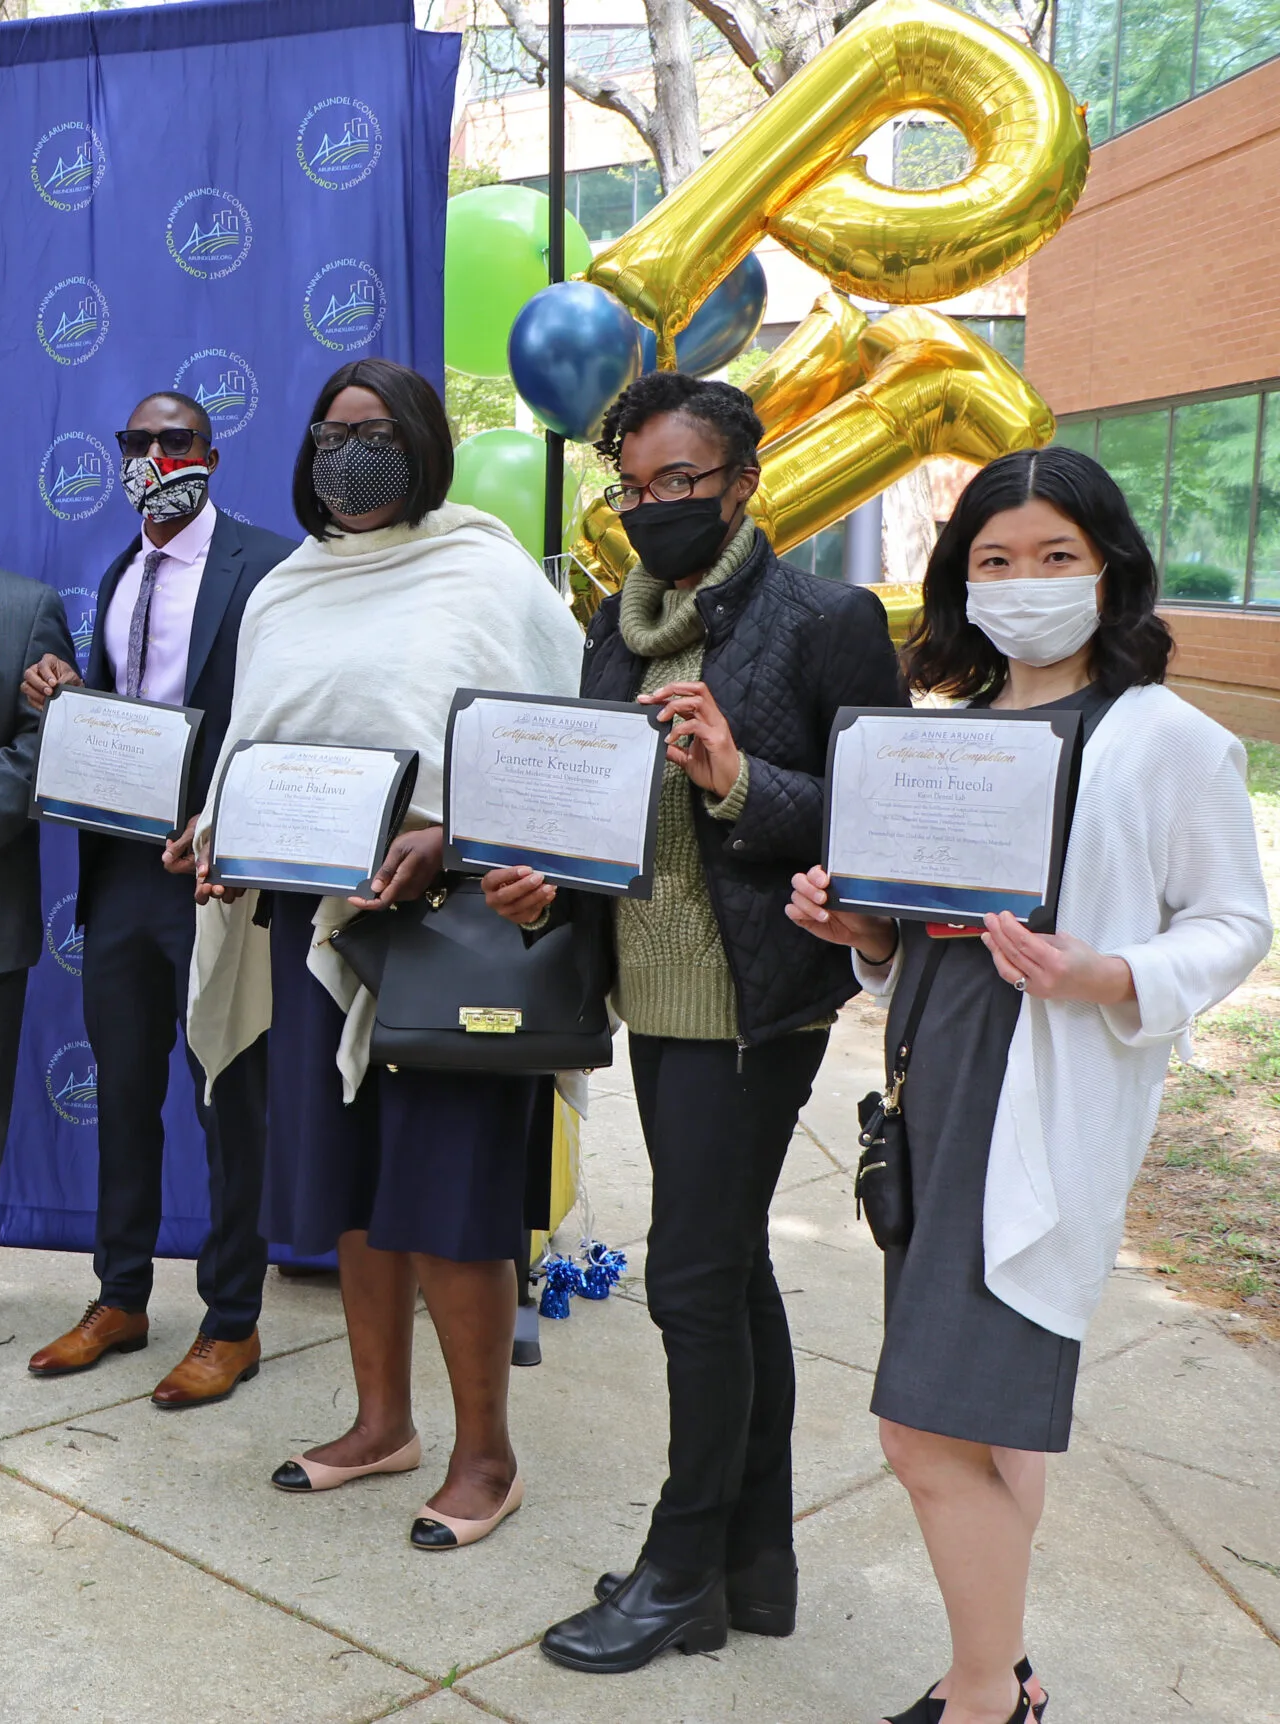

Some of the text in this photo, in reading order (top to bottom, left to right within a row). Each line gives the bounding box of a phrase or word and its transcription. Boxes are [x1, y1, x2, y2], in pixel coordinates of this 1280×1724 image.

[314, 96, 351, 114] ARUNDEL
[298, 110, 314, 135] ANNE
[352, 99, 382, 140] ECONOMIC
[31, 121, 84, 212] ANNE ARUNDEL CORPORATION
[296, 144, 338, 190] CORPORATION
[184, 187, 220, 203] ARUNDEL
[170, 201, 184, 223] ANNE
[222, 192, 253, 232] ECONOMIC
[166, 232, 206, 279] CORPORATION
[322, 258, 357, 275] ARUNDEL
[306, 272, 322, 296] ANNE
[359, 262, 385, 304] ECONOMIC
[39, 290, 54, 313] ANNE
[54, 276, 85, 291] ARUNDEL
[87, 279, 110, 318] ECONOMIC
[304, 304, 342, 351] CORPORATION
[175, 360, 190, 383] ANNE
[190, 349, 227, 363] ARUNDEL
[229, 352, 258, 394] ECONOMIC
[54, 432, 84, 447] ARUNDEL
[41, 446, 54, 467] ANNE
[86, 435, 114, 476] ECONOMIC
[38, 475, 70, 520] CORPORATION
[533, 716, 556, 724] ANNE
[559, 718, 598, 729] ARUNDEL
[111, 739, 144, 754] Kamara
[492, 726, 544, 743] Certificate
[559, 734, 617, 750] Completion
[921, 731, 995, 741] ANNE ARUNDEL
[495, 750, 543, 768] Jeanette
[547, 756, 611, 778] Kreuzburg
[877, 745, 934, 763] Certificate
[949, 747, 1015, 765] Completion
[269, 780, 303, 792] Liliane
[894, 772, 942, 789] Hiromi
[48, 901, 63, 922] ANNE
[47, 929, 82, 976] CORPORATION
[45, 1048, 79, 1125] ANNE CORPORATION
